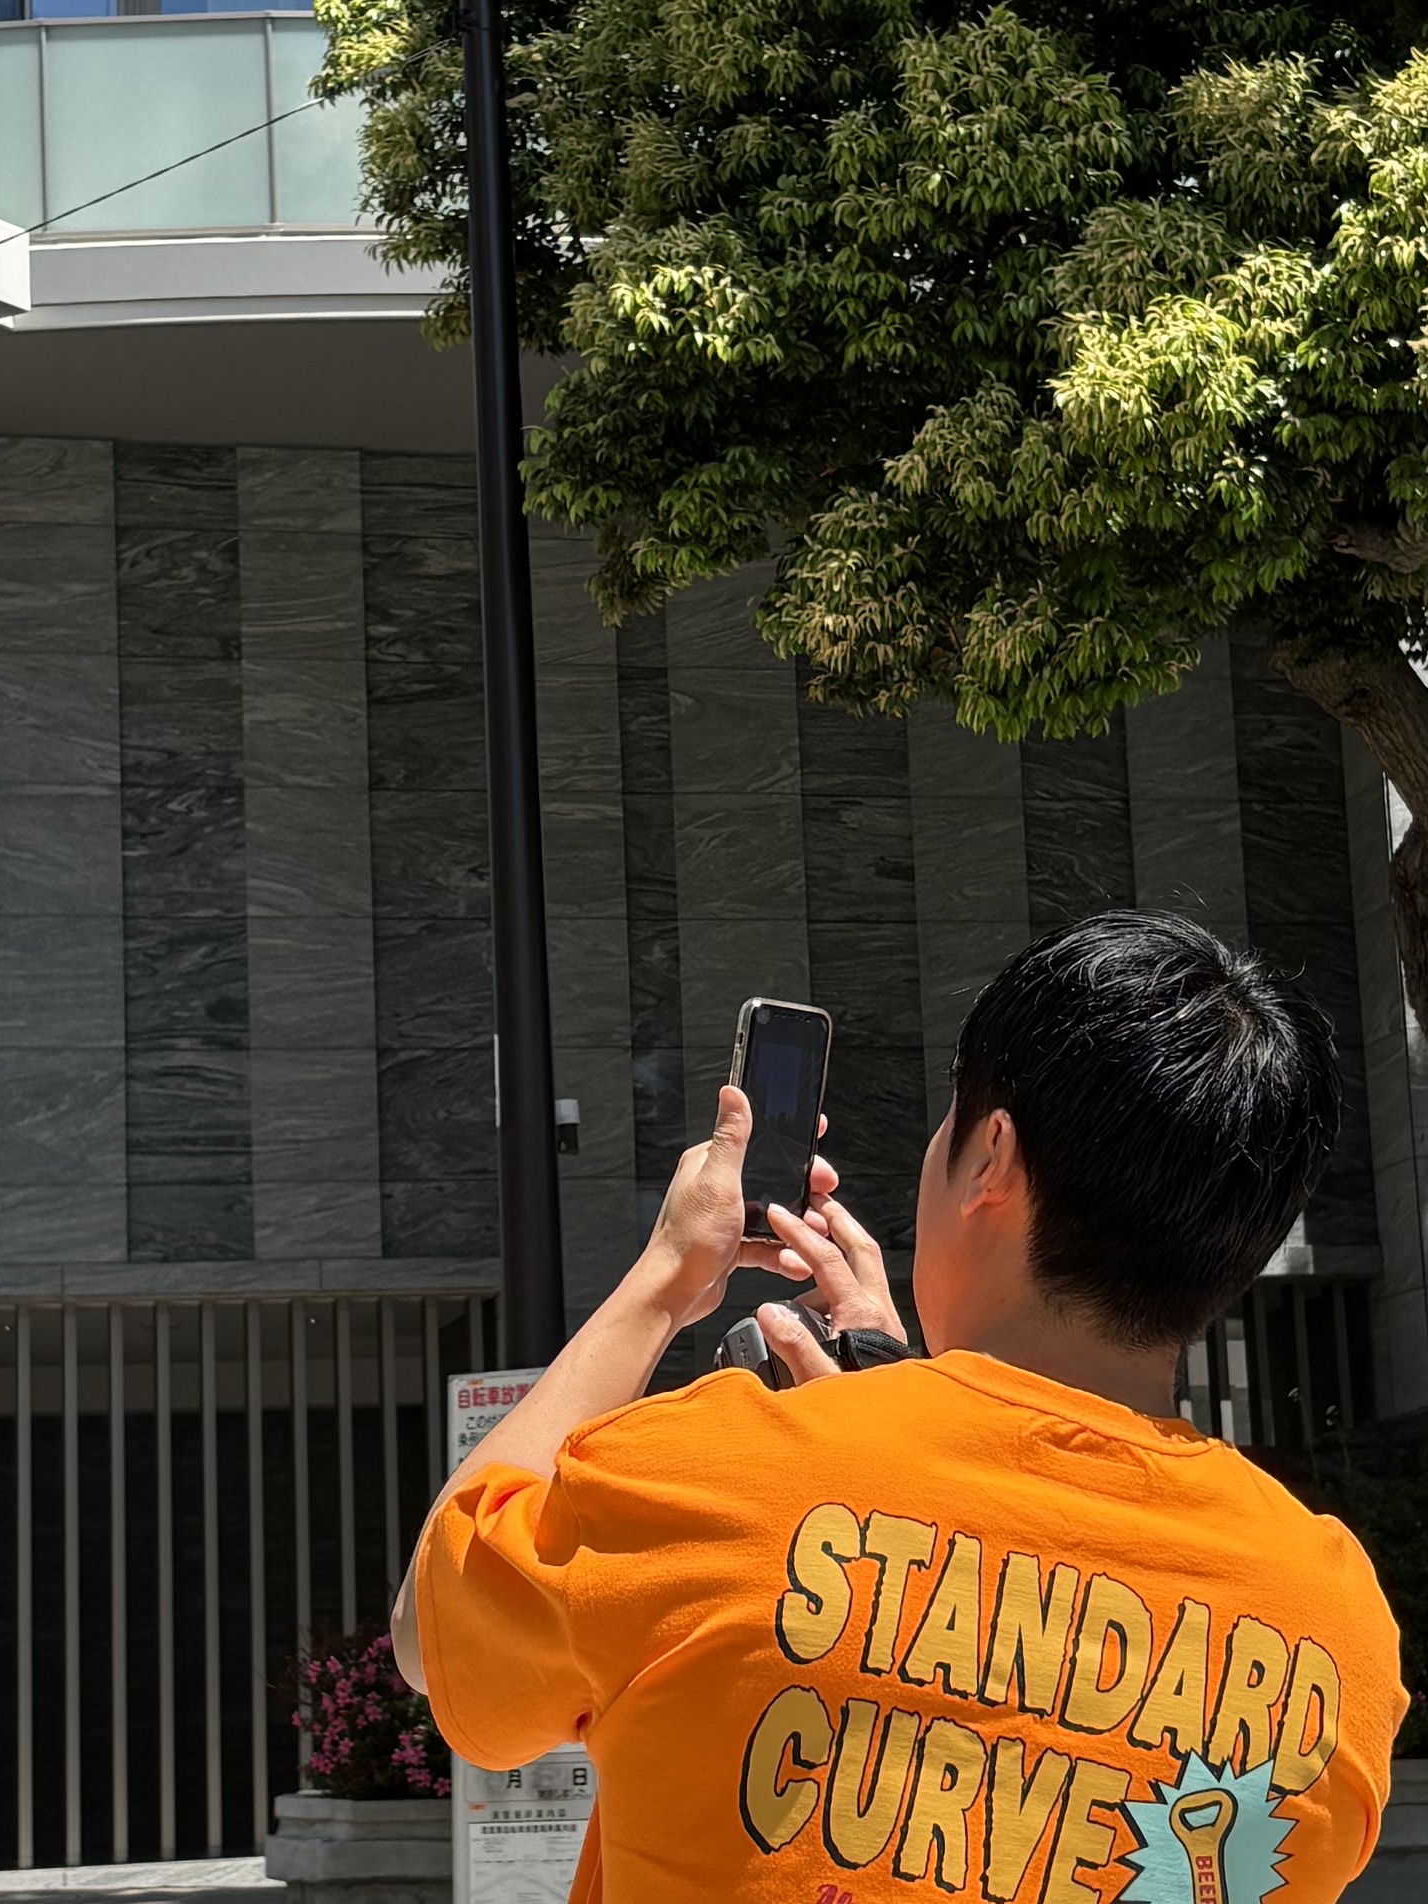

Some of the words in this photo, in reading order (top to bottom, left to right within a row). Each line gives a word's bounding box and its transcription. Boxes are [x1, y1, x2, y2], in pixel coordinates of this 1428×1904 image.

[775, 1501, 1341, 1796] STANDARD
[506, 1769, 522, 1789] 月
[572, 1768, 588, 1786] 日
